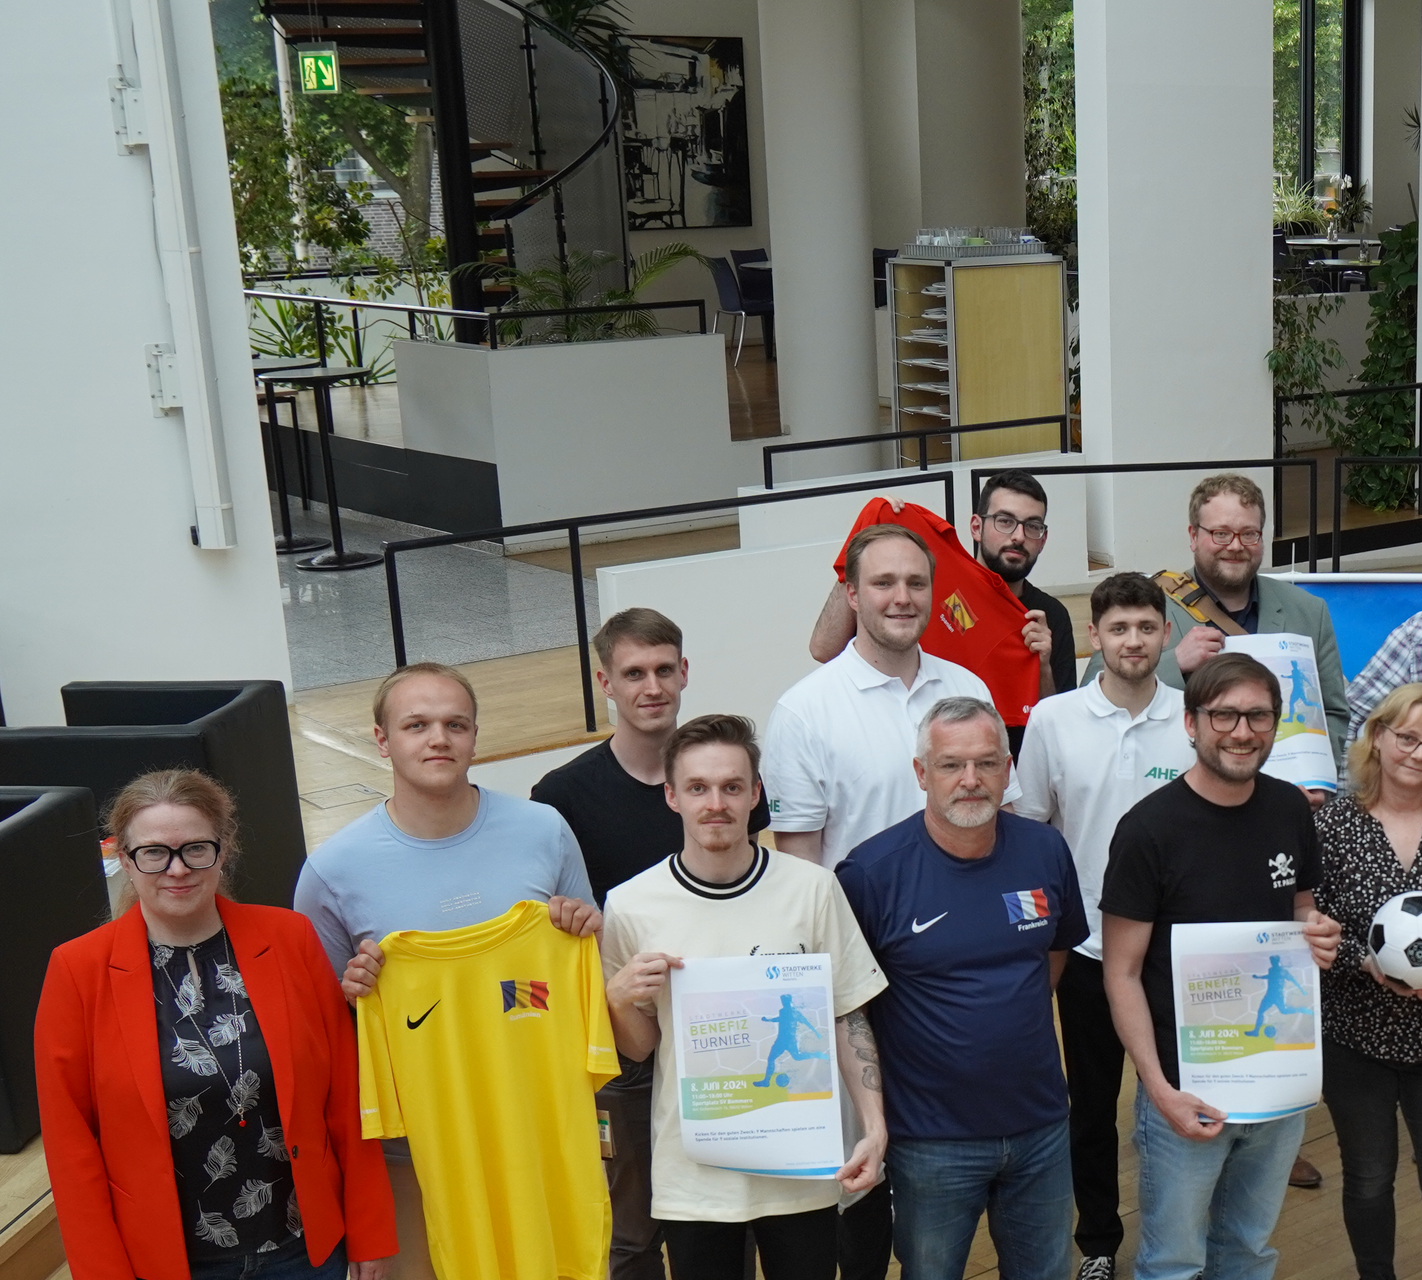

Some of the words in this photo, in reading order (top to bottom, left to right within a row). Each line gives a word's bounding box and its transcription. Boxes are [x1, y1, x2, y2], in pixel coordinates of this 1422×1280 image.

[940, 613, 955, 633] Spanien
[1144, 766, 1179, 781] AHE
[767, 799, 781, 813] HE
[1017, 918, 1048, 932] Frankreich
[782, 964, 822, 972] STADTWERKE
[1188, 976, 1240, 991] BENEFIZ
[1190, 988, 1242, 1003] TURNIER
[690, 1019, 748, 1036] BENEFIZ
[1198, 1029, 1215, 1038] JUNI
[1217, 1029, 1239, 1038] 2024
[692, 1032, 751, 1050] TURNIER
[691, 1082, 699, 1092] 8.
[702, 1081, 720, 1091] JUNI
[722, 1080, 747, 1090] 2024
